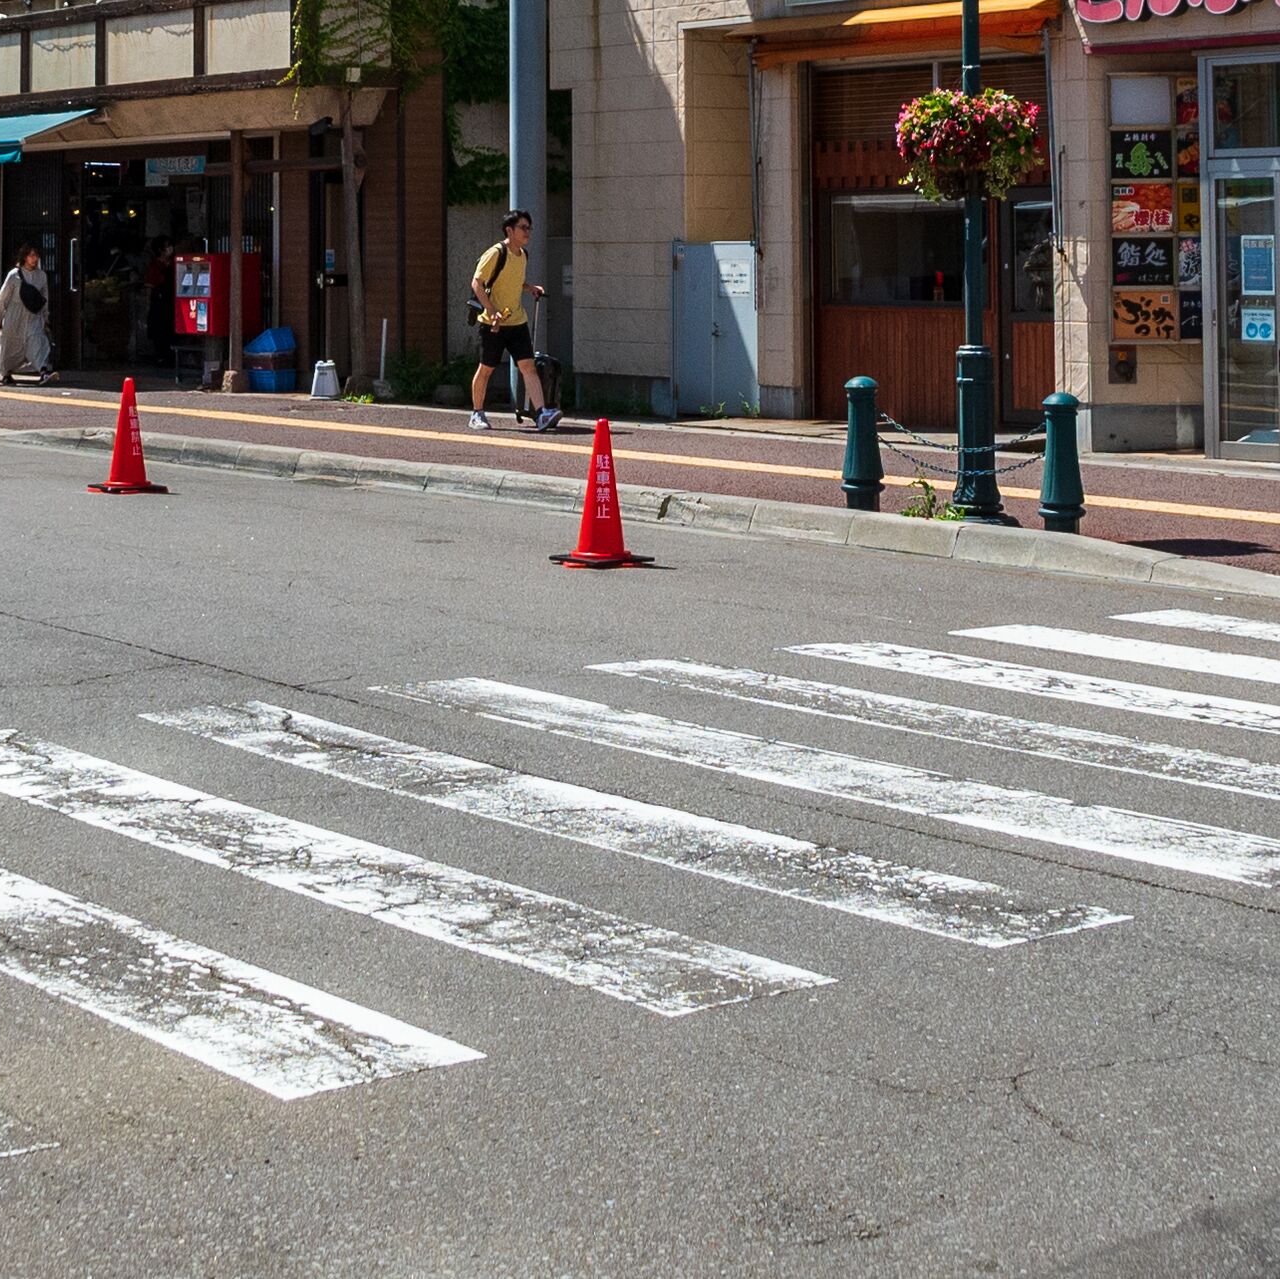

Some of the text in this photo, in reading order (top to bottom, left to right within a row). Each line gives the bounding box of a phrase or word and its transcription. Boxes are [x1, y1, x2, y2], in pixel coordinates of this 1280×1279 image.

[1117, 241, 1168, 267] 鮨処
[596, 454, 611, 519] 駐車禁止
